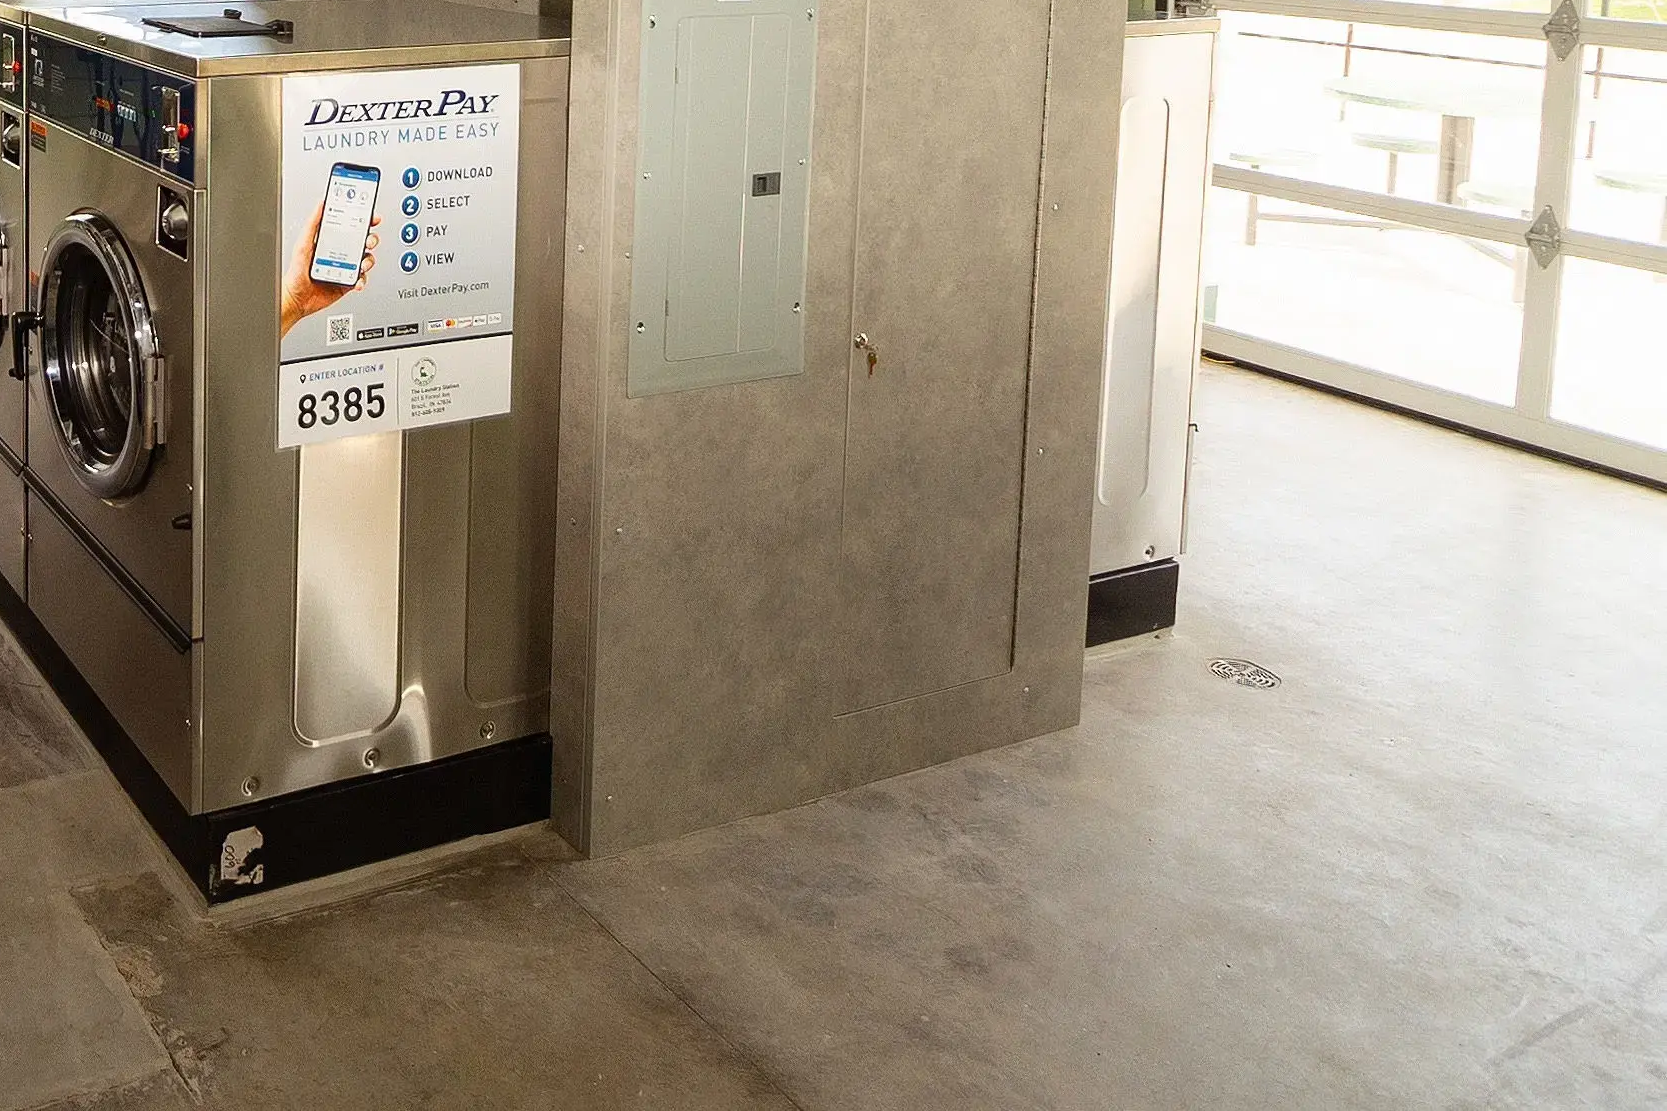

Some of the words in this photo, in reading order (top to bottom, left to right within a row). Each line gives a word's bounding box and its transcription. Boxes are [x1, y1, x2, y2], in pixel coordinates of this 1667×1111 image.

[88, 127, 115, 145] DEXTER
[303, 130, 390, 151] LAUNDRY
[398, 125, 447, 144] MADE
[456, 122, 500, 139] EASY
[427, 166, 493, 182] DOWNLOAD
[426, 195, 471, 210] SELECT
[426, 224, 448, 238] PAY
[425, 252, 455, 266] VIEW
[398, 288, 418, 299] Visit
[420, 281, 489, 297] DexterPay.com
[309, 369, 336, 382] ENTER
[337, 364, 376, 378] LOCATION
[297, 382, 385, 429] 8385
